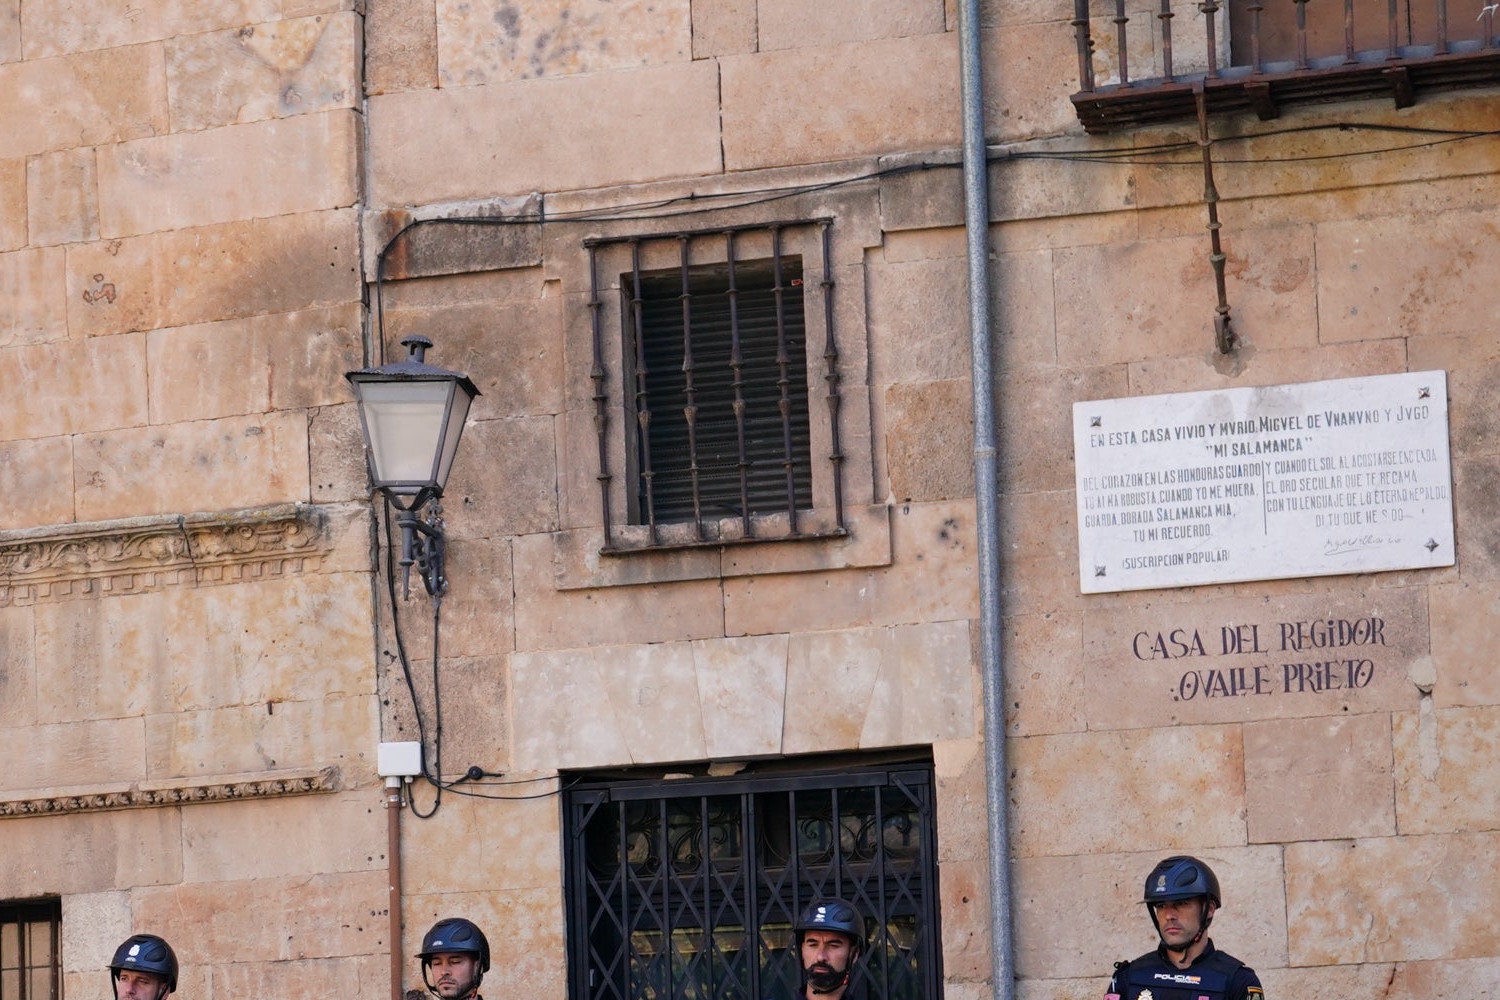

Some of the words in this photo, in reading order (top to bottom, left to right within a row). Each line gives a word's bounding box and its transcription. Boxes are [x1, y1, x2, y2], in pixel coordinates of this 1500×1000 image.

[1090, 434, 1105, 448] EN
[1109, 431, 1138, 446] ESTA
[1142, 428, 1171, 443] CASA
[1174, 425, 1205, 440] VIVIO
[1209, 423, 1216, 437] Y
[1307, 414, 1321, 429] DE
[1384, 408, 1392, 422] Y
[1265, 461, 1271, 475] Y
[1274, 458, 1307, 475] CUANDO
[1308, 457, 1319, 472] EL
[1320, 456, 1336, 471] SOL
[1339, 455, 1350, 469] AL
[1083, 476, 1099, 491] DEL
[1145, 471, 1156, 486] EN
[1158, 470, 1176, 485] LAS
[1265, 480, 1277, 495] EL
[1280, 478, 1297, 493] ORO
[1299, 475, 1342, 492] SECULAR
[1159, 487, 1193, 504] CUANDO
[1195, 486, 1207, 500] YO
[1209, 484, 1222, 499] ME
[1266, 497, 1284, 513] CON
[1287, 496, 1298, 511] TU
[1346, 492, 1357, 507] DE
[1156, 505, 1213, 522] SALAMANCA
[1328, 513, 1340, 527] TU
[1366, 509, 1378, 524] HE
[1133, 528, 1145, 543] TU
[1148, 527, 1158, 541] MI
[1132, 628, 1208, 661] CASA
[1220, 623, 1269, 656] DEL
[1179, 665, 1274, 701] OVALLE
